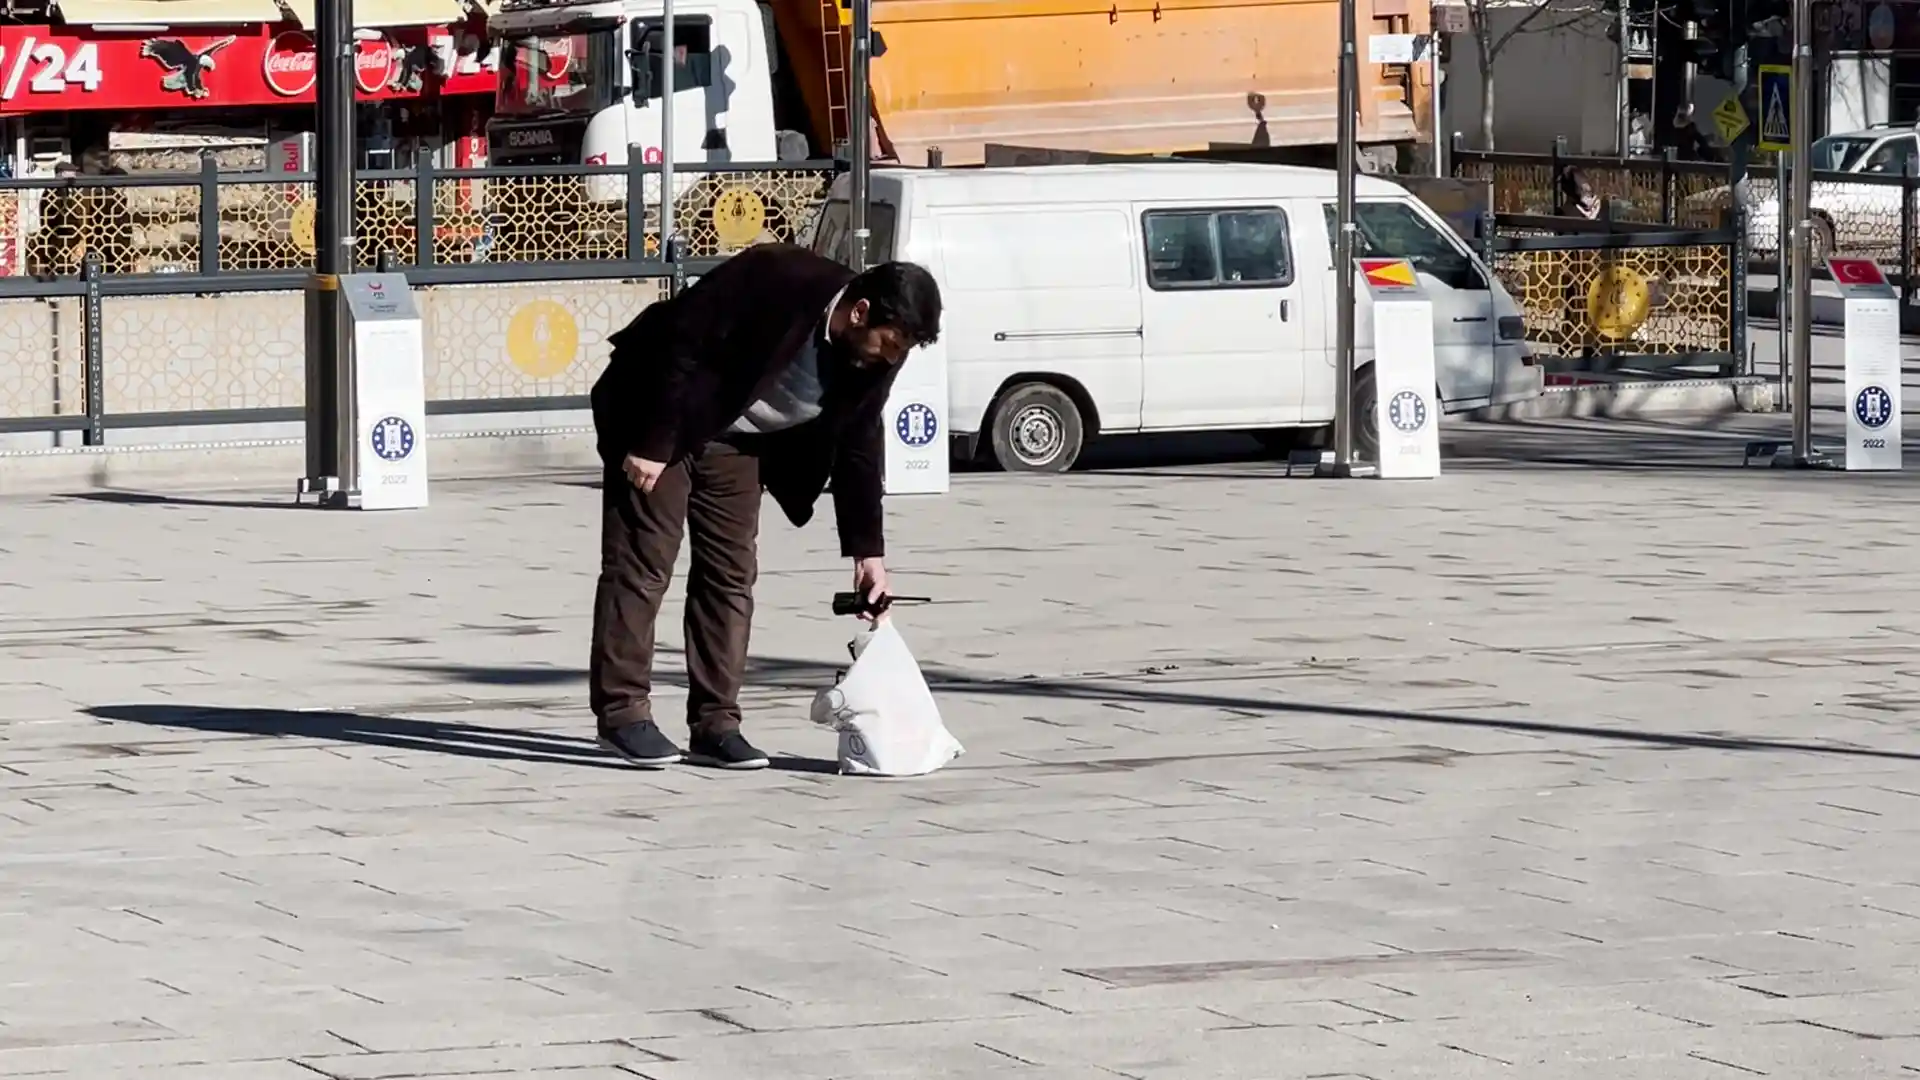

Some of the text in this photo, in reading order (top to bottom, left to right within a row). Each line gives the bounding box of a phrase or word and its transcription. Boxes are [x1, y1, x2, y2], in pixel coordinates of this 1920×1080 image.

[509, 129, 554, 147] SCANIA
[1862, 438, 1885, 449] 2022
[905, 460, 930, 470] 2022
[381, 475, 407, 485] 2022
